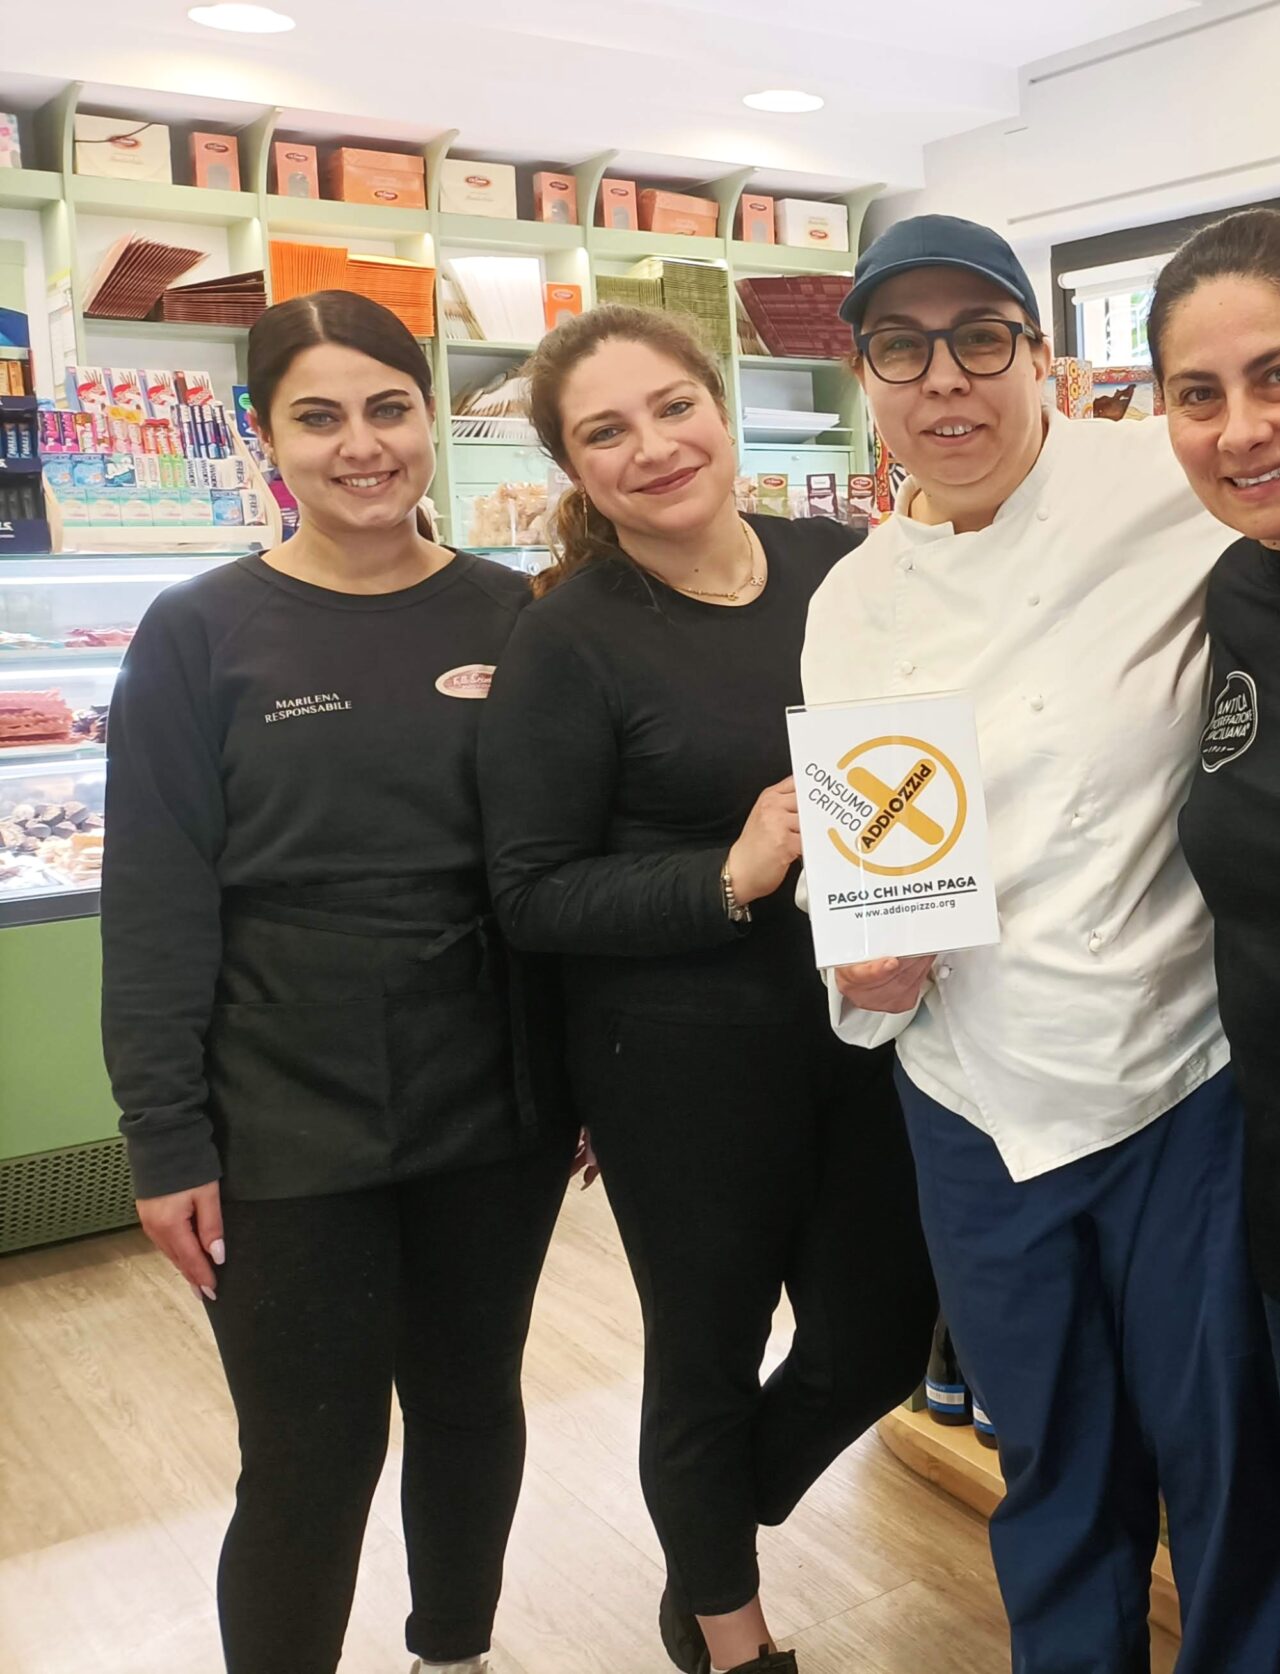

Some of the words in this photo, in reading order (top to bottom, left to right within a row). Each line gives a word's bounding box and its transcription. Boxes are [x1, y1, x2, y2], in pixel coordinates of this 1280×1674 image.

[264, 700, 352, 723] RESPONSABILE
[275, 692, 340, 709] MARILENA
[1218, 693, 1247, 715] ANTICA
[805, 762, 873, 818] CONSUMO
[808, 788, 862, 831] CRITICO
[827, 891, 869, 905] PAGO
[873, 886, 898, 899] CHI
[902, 881, 933, 895] NON
[937, 876, 977, 890] PAGA
